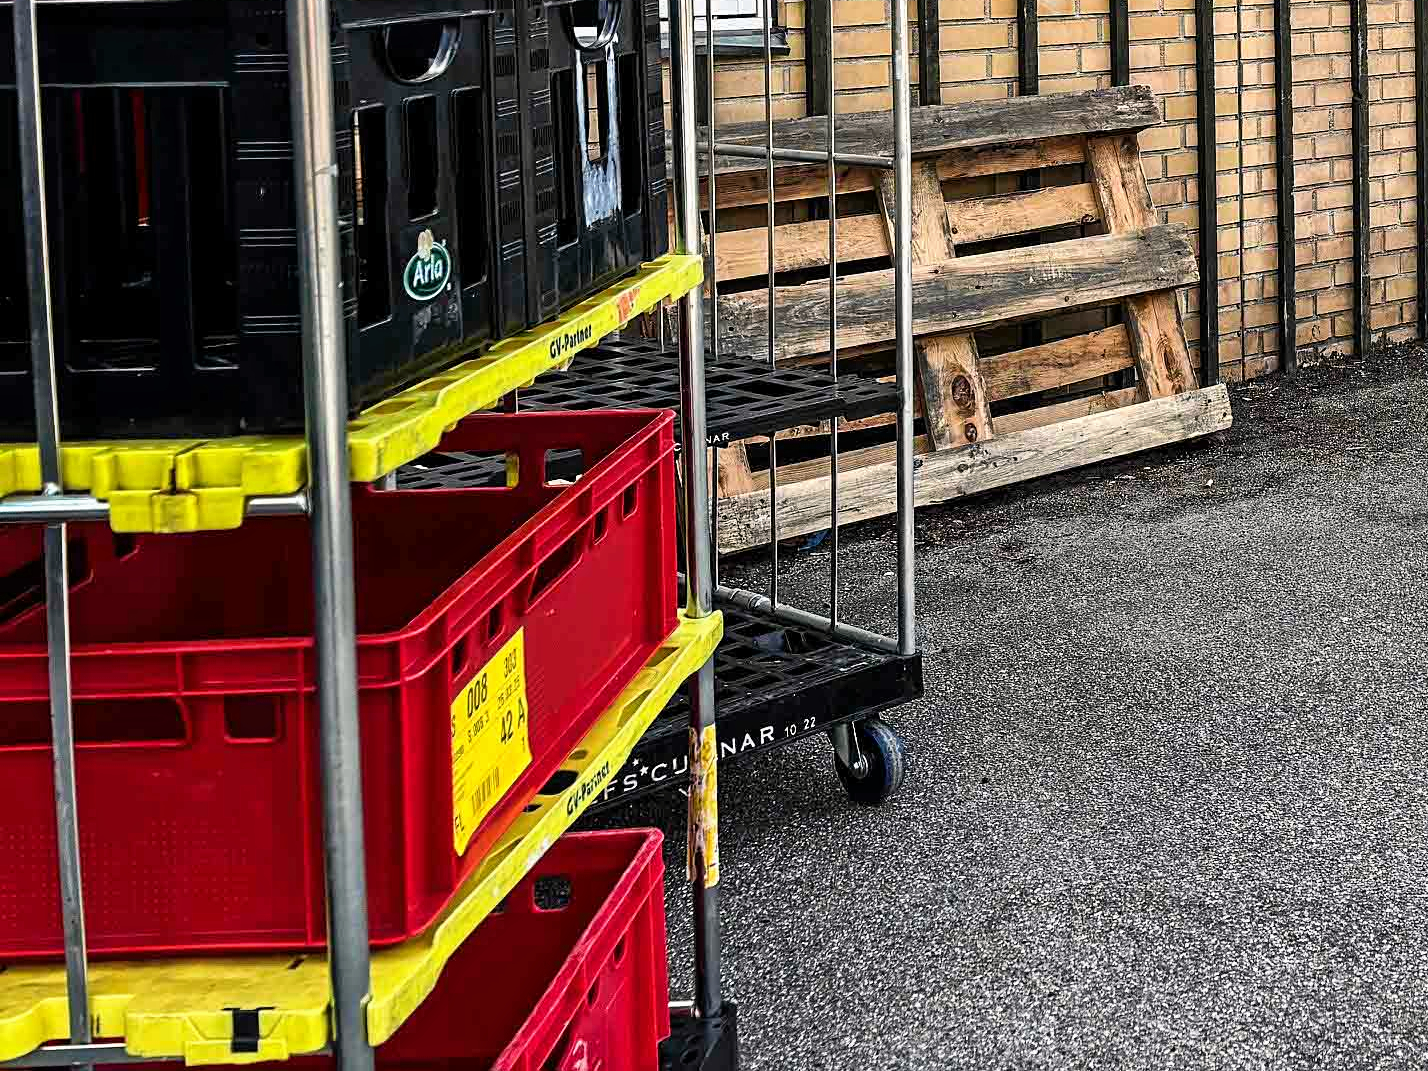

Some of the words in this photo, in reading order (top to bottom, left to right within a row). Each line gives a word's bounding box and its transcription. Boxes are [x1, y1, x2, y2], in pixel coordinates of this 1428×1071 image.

[413, 253, 444, 288] Arla
[549, 325, 592, 359] GV-Partner
[467, 673, 488, 718] 008
[501, 710, 514, 745] 42
[518, 697, 525, 729] A
[651, 725, 775, 782] CUNAR
[784, 724, 797, 737] 10
[804, 716, 816, 730] 22
[566, 761, 609, 817] GV-Partner
